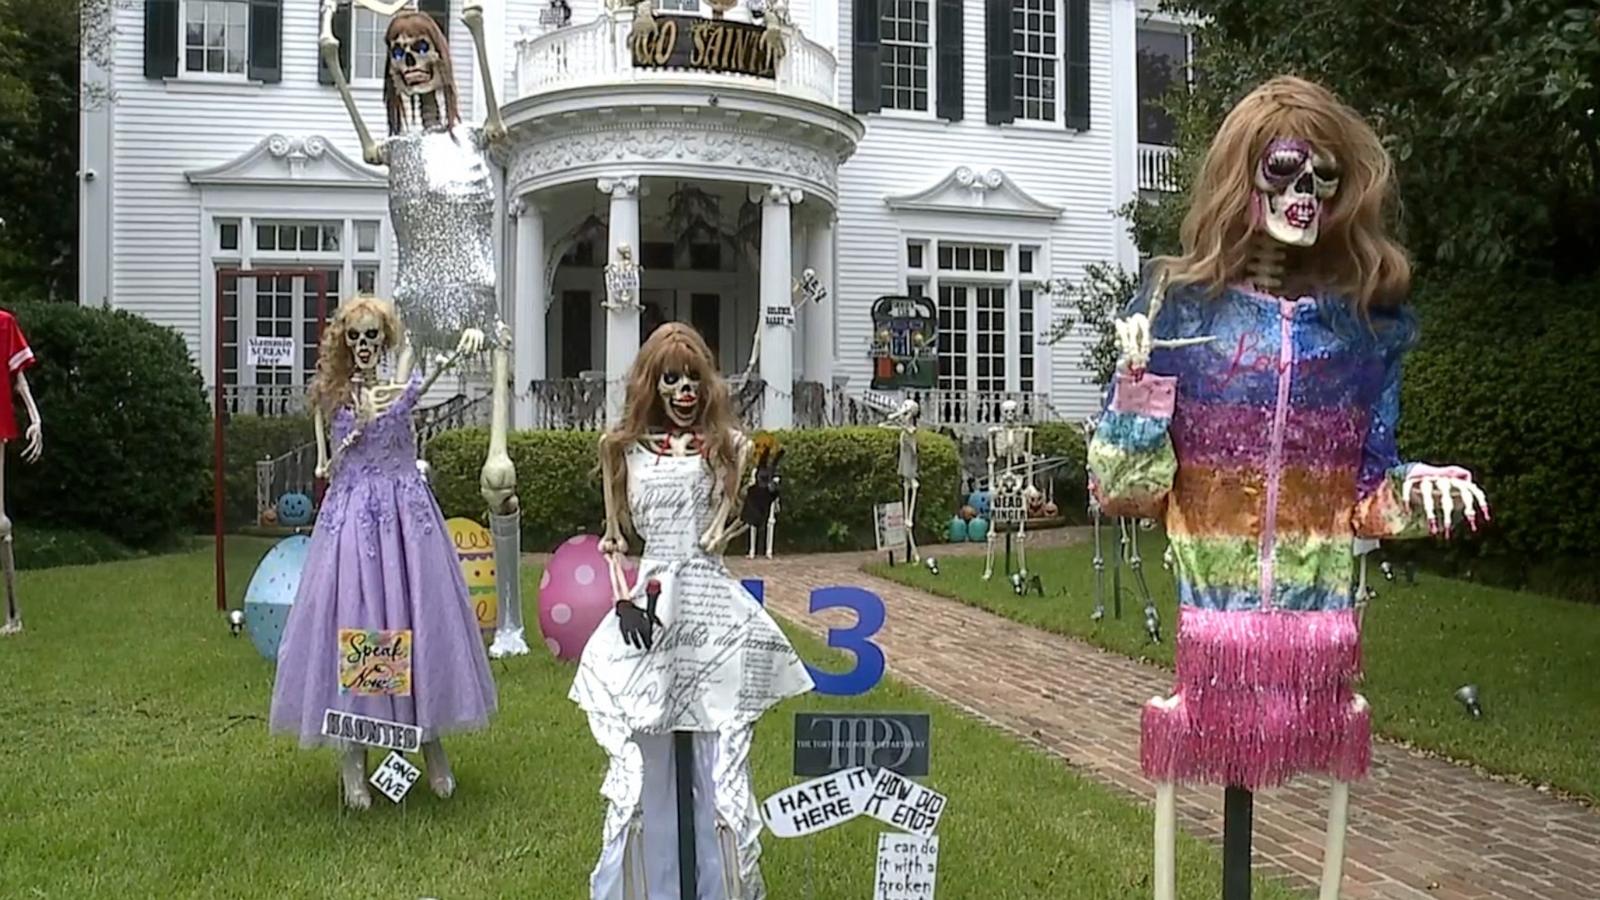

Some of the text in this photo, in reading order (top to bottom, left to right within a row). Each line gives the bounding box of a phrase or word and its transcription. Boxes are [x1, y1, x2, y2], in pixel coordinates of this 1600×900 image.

[994, 496, 1023, 508] DEAD
[347, 633, 404, 666] Speak
[326, 712, 417, 750] HAUNTED
[384, 755, 417, 783] LONG
[763, 768, 867, 821] I HATE IT
[874, 773, 944, 815] HOW DID
[793, 797, 854, 832] HERE
[863, 793, 936, 835] IT END?
[879, 834, 937, 855] I can do
[878, 855, 935, 875] it with a
[878, 873, 932, 896] broken
